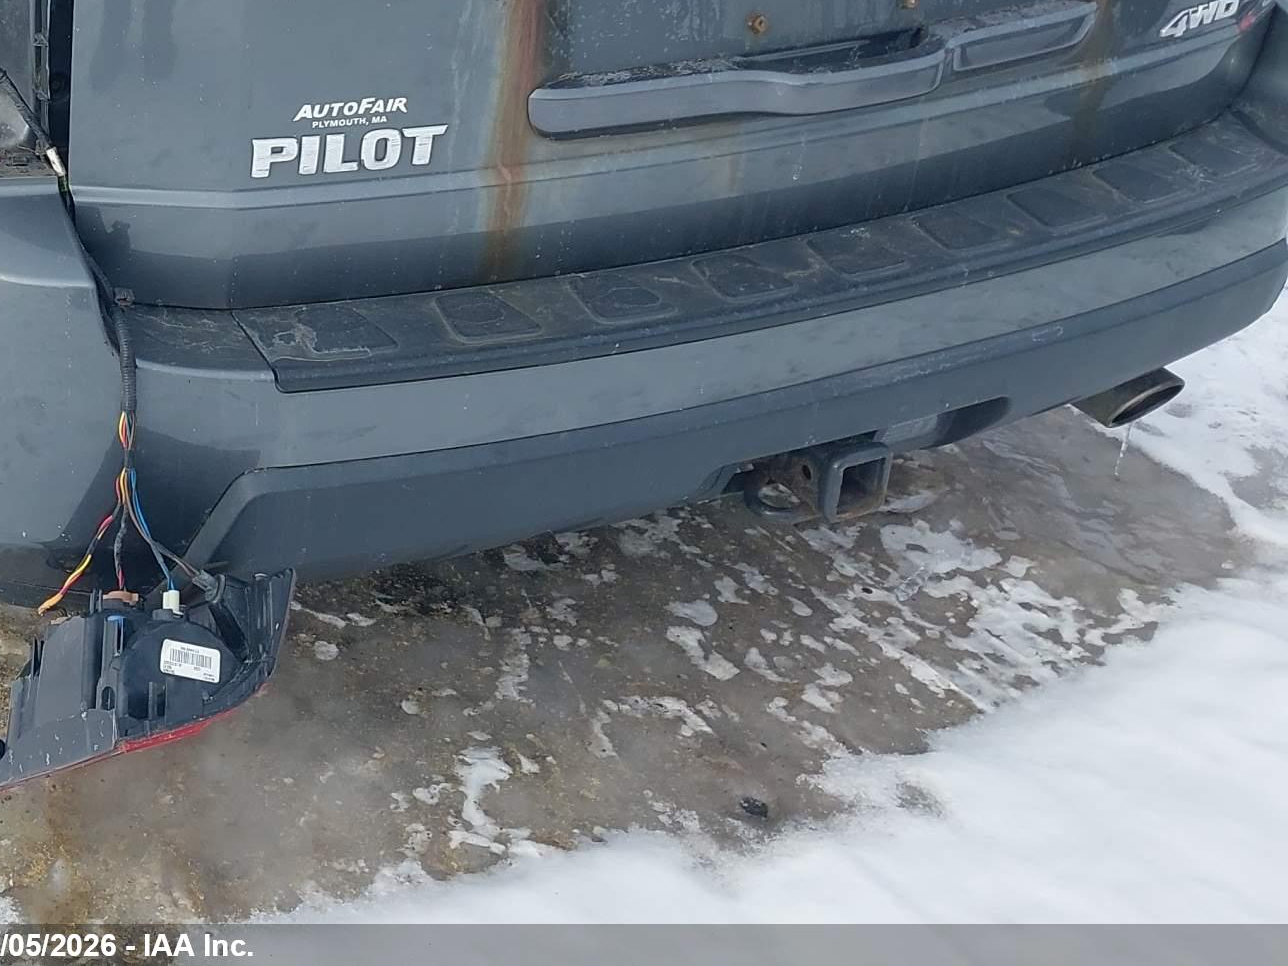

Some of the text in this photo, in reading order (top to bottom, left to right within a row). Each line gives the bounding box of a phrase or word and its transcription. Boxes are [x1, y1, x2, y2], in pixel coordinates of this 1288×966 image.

[312, 115, 388, 129] PLYMOUTH, MA
[250, 124, 449, 178] PILOT
